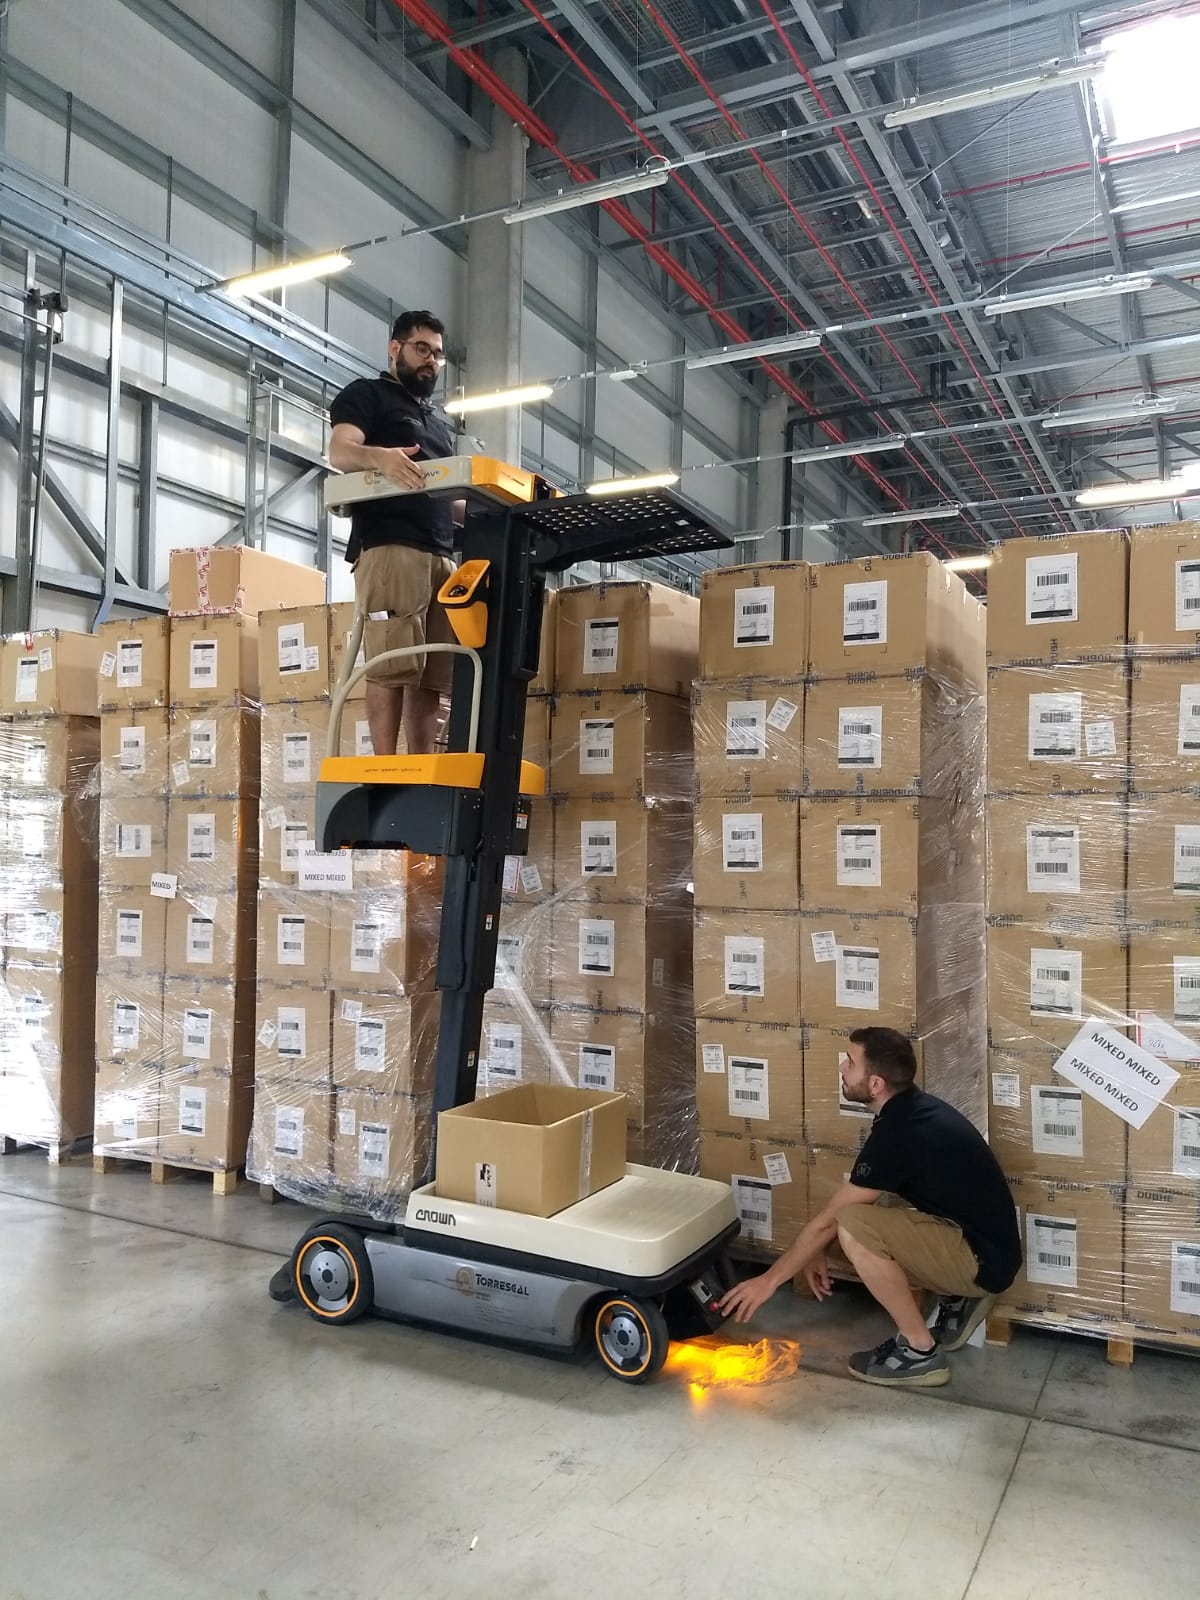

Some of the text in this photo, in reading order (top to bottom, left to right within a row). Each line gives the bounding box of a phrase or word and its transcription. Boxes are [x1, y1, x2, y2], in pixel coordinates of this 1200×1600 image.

[152, 881, 171, 890] MIXED
[1091, 1032, 1126, 1061] MIXED
[1125, 1057, 1161, 1086] MIXED
[1070, 1058, 1139, 1112] MIXED MIXED
[1137, 1191, 1174, 1203] DUBHE
[415, 1209, 456, 1226] CROWN
[475, 1273, 530, 1296] TORRESGAL
